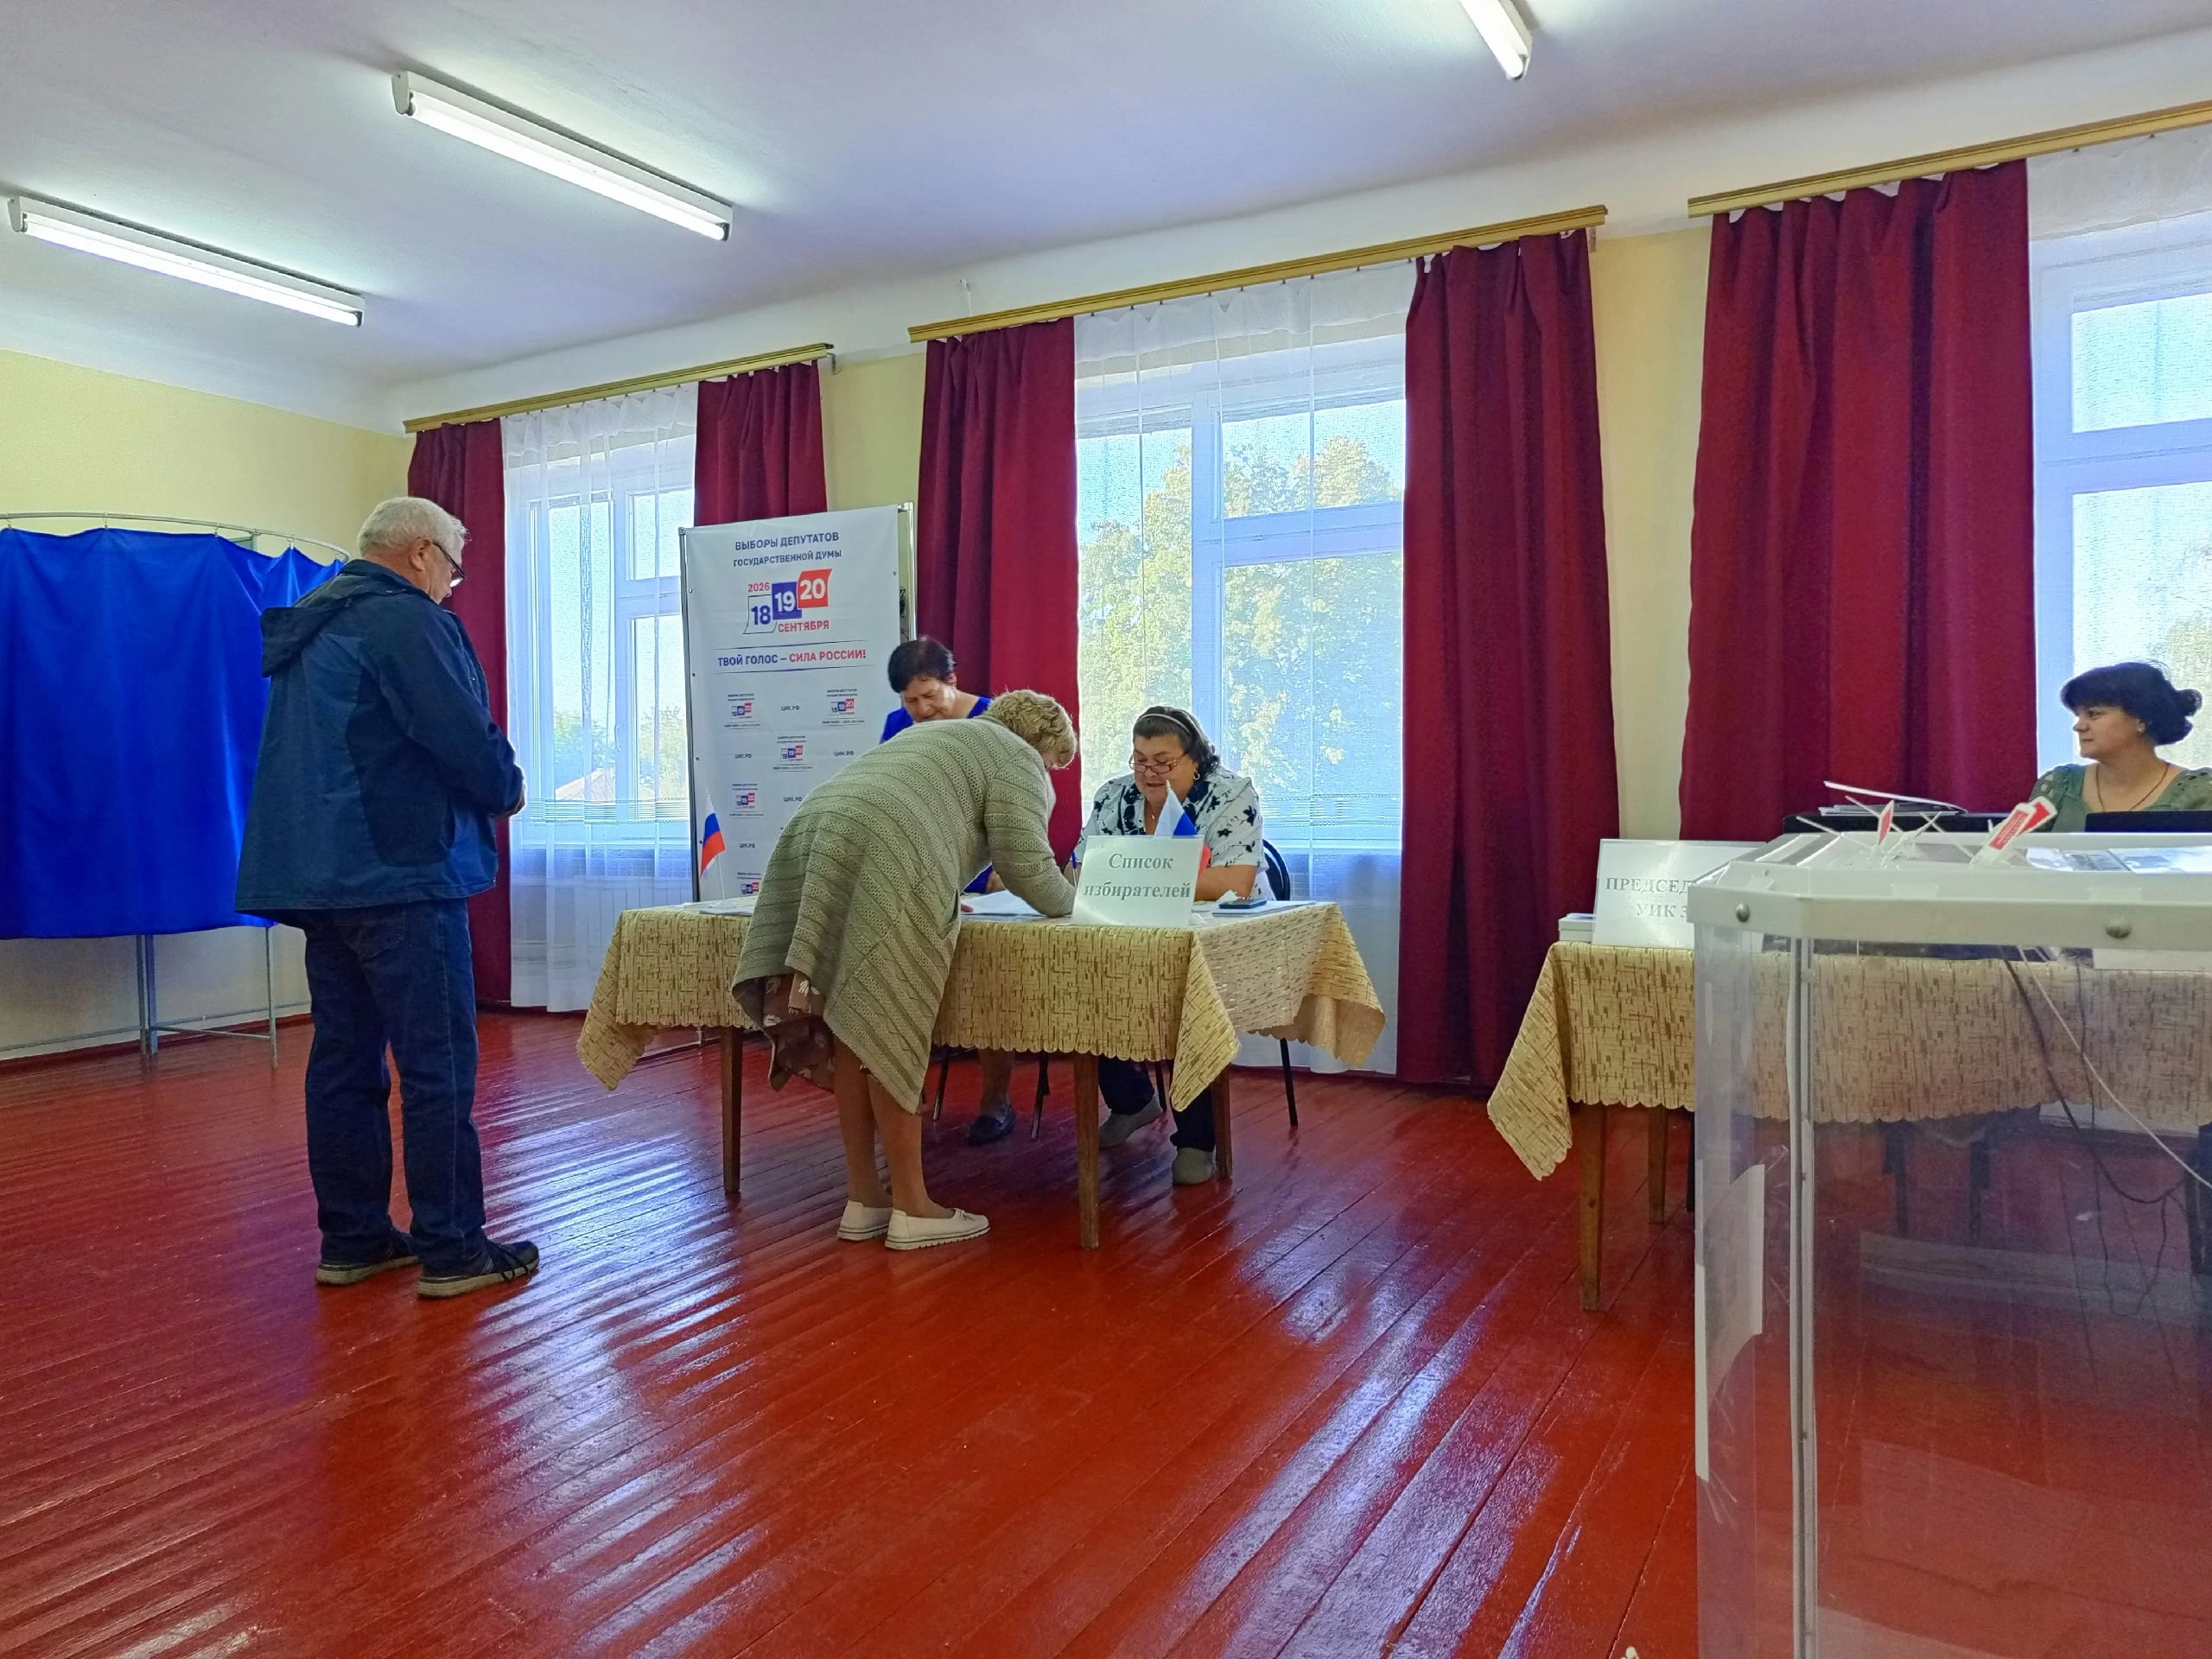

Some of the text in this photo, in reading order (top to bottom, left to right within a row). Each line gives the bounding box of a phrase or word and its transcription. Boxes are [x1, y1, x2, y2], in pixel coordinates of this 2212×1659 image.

[734, 531, 840, 551] ВЫБОРЫ ДЕПУТАТОВ
[733, 549, 842, 568] ГОСУДАРСТВЕННОЙ ДУМЫ
[747, 582, 771, 593] 2026
[799, 577, 827, 601] 20
[774, 590, 796, 613] 19
[751, 605, 772, 626] 18
[778, 620, 830, 633] СЕНТЯБРЯ
[717, 654, 744, 667] ТВОЙ
[745, 654, 779, 665] ГОЛОС
[789, 652, 817, 663] СИЛА
[818, 649, 867, 661] РОССИИ!
[1108, 852, 1174, 869] Список
[1083, 881, 1192, 901] избирателей
[1636, 903, 1676, 918] УИК
